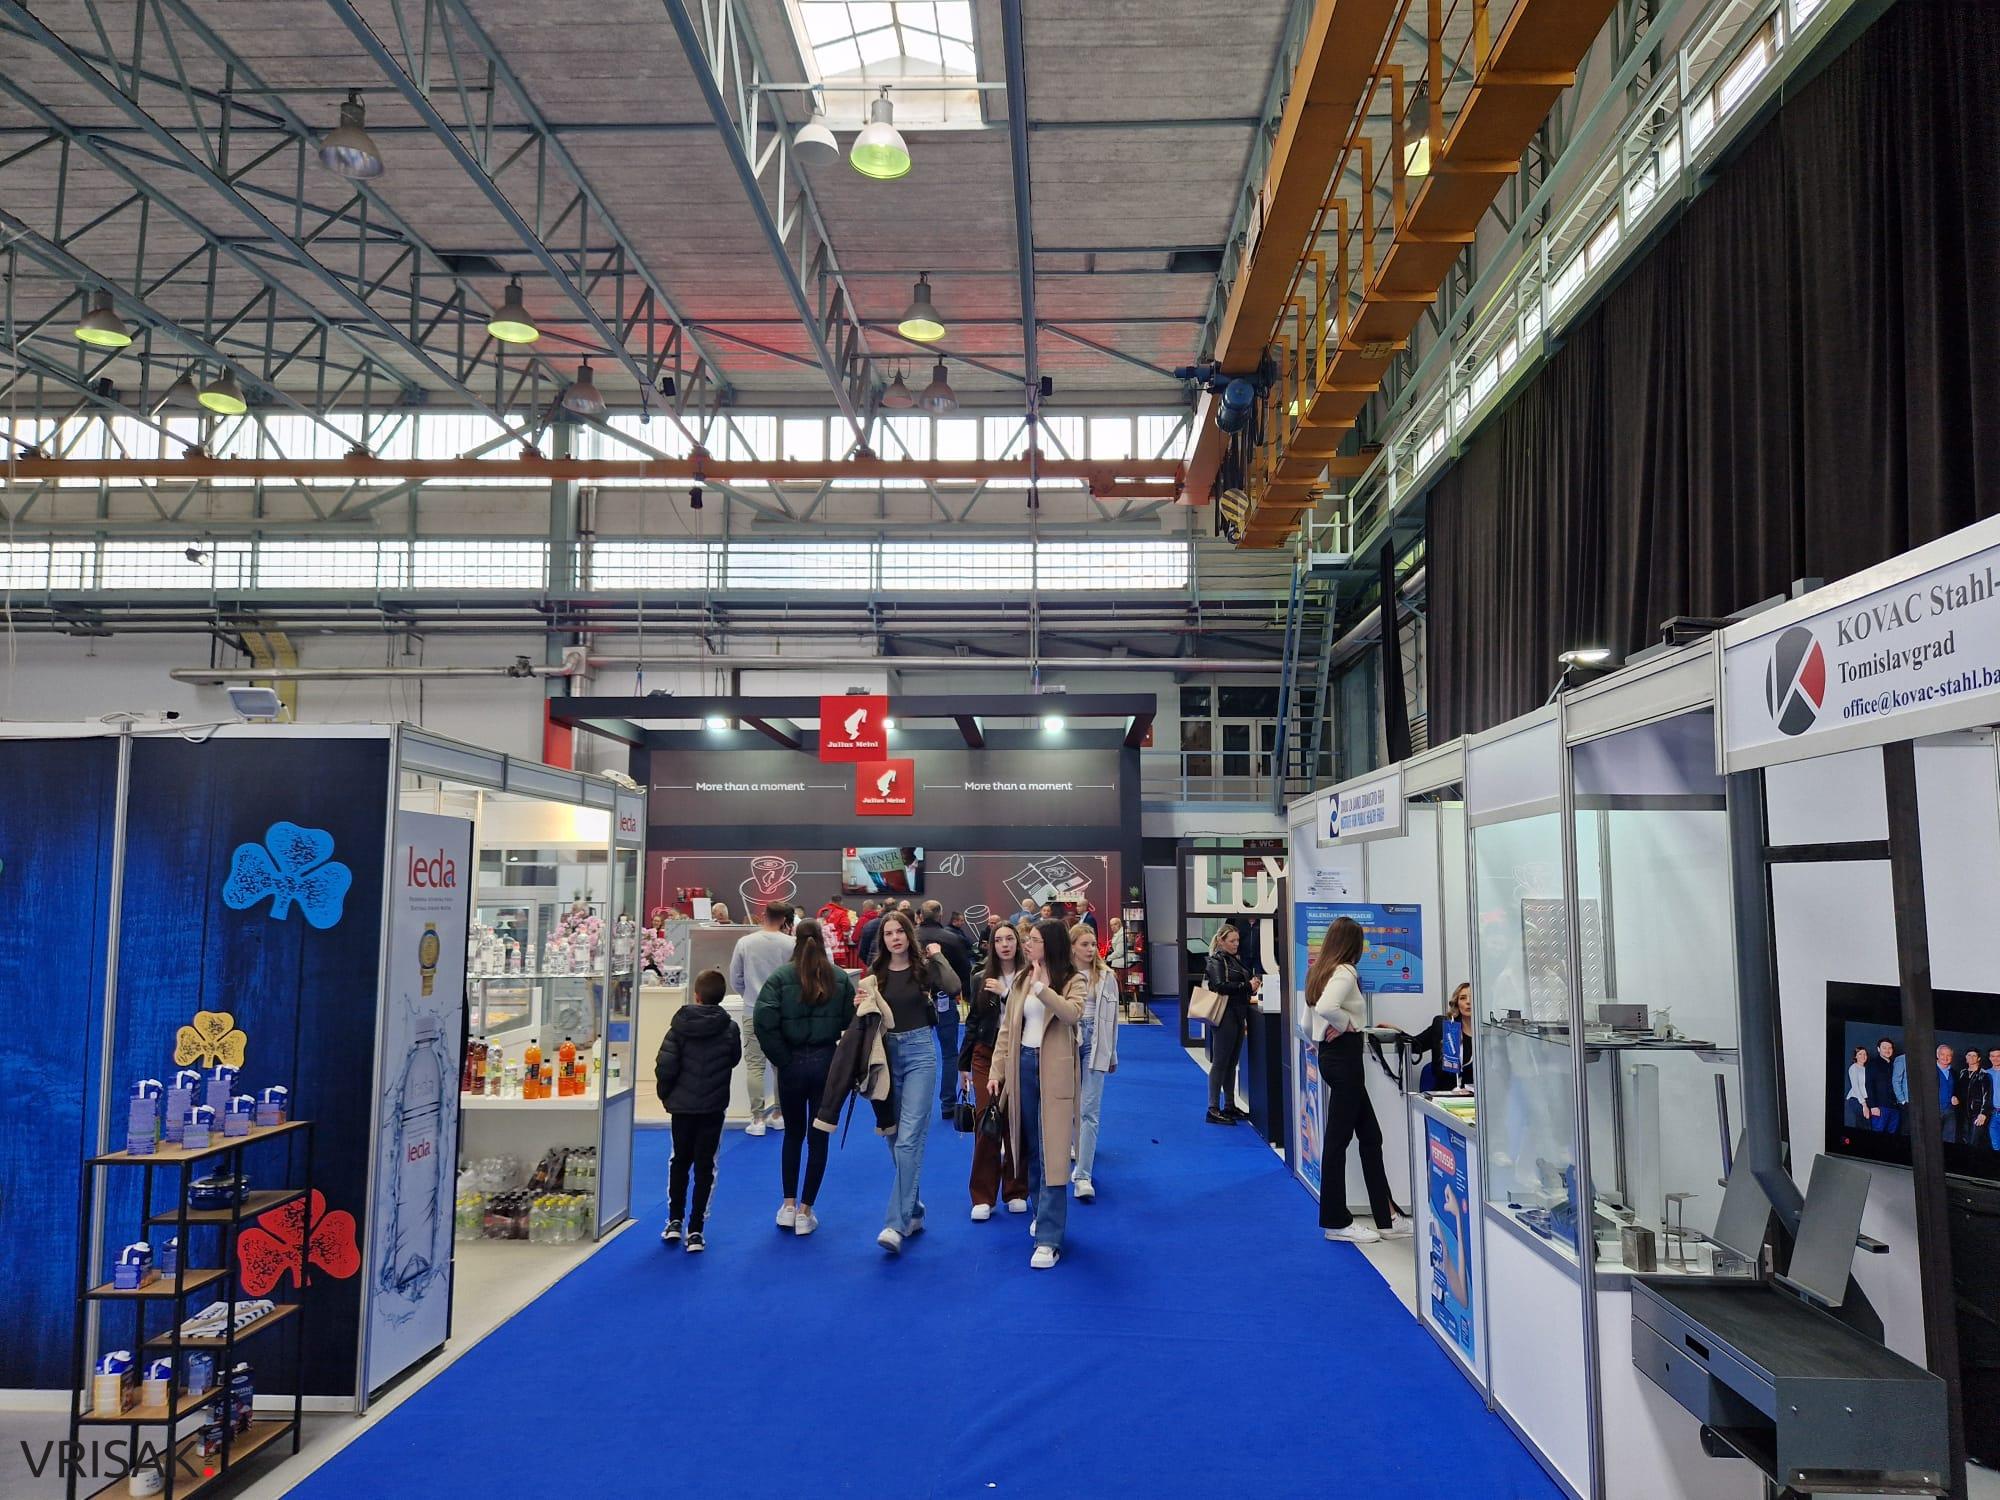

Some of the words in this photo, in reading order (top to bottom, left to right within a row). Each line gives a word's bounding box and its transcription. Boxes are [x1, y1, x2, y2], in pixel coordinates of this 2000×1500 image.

[1837, 592, 1923, 647] KOVAC
[1838, 630, 1955, 684] Tomislavgrad
[1843, 667, 2000, 719] office@kovac-stahl.ba
[696, 782, 723, 791] More
[724, 782, 750, 791] than
[760, 782, 805, 791] moment
[964, 782, 991, 791] More
[992, 782, 1018, 791] than
[1028, 782, 1072, 791] moment
[619, 811, 637, 832] leda
[407, 845, 457, 889] leda
[860, 851, 898, 865] WIENER
[868, 861, 895, 872] BLATT
[407, 1137, 432, 1163] leda
